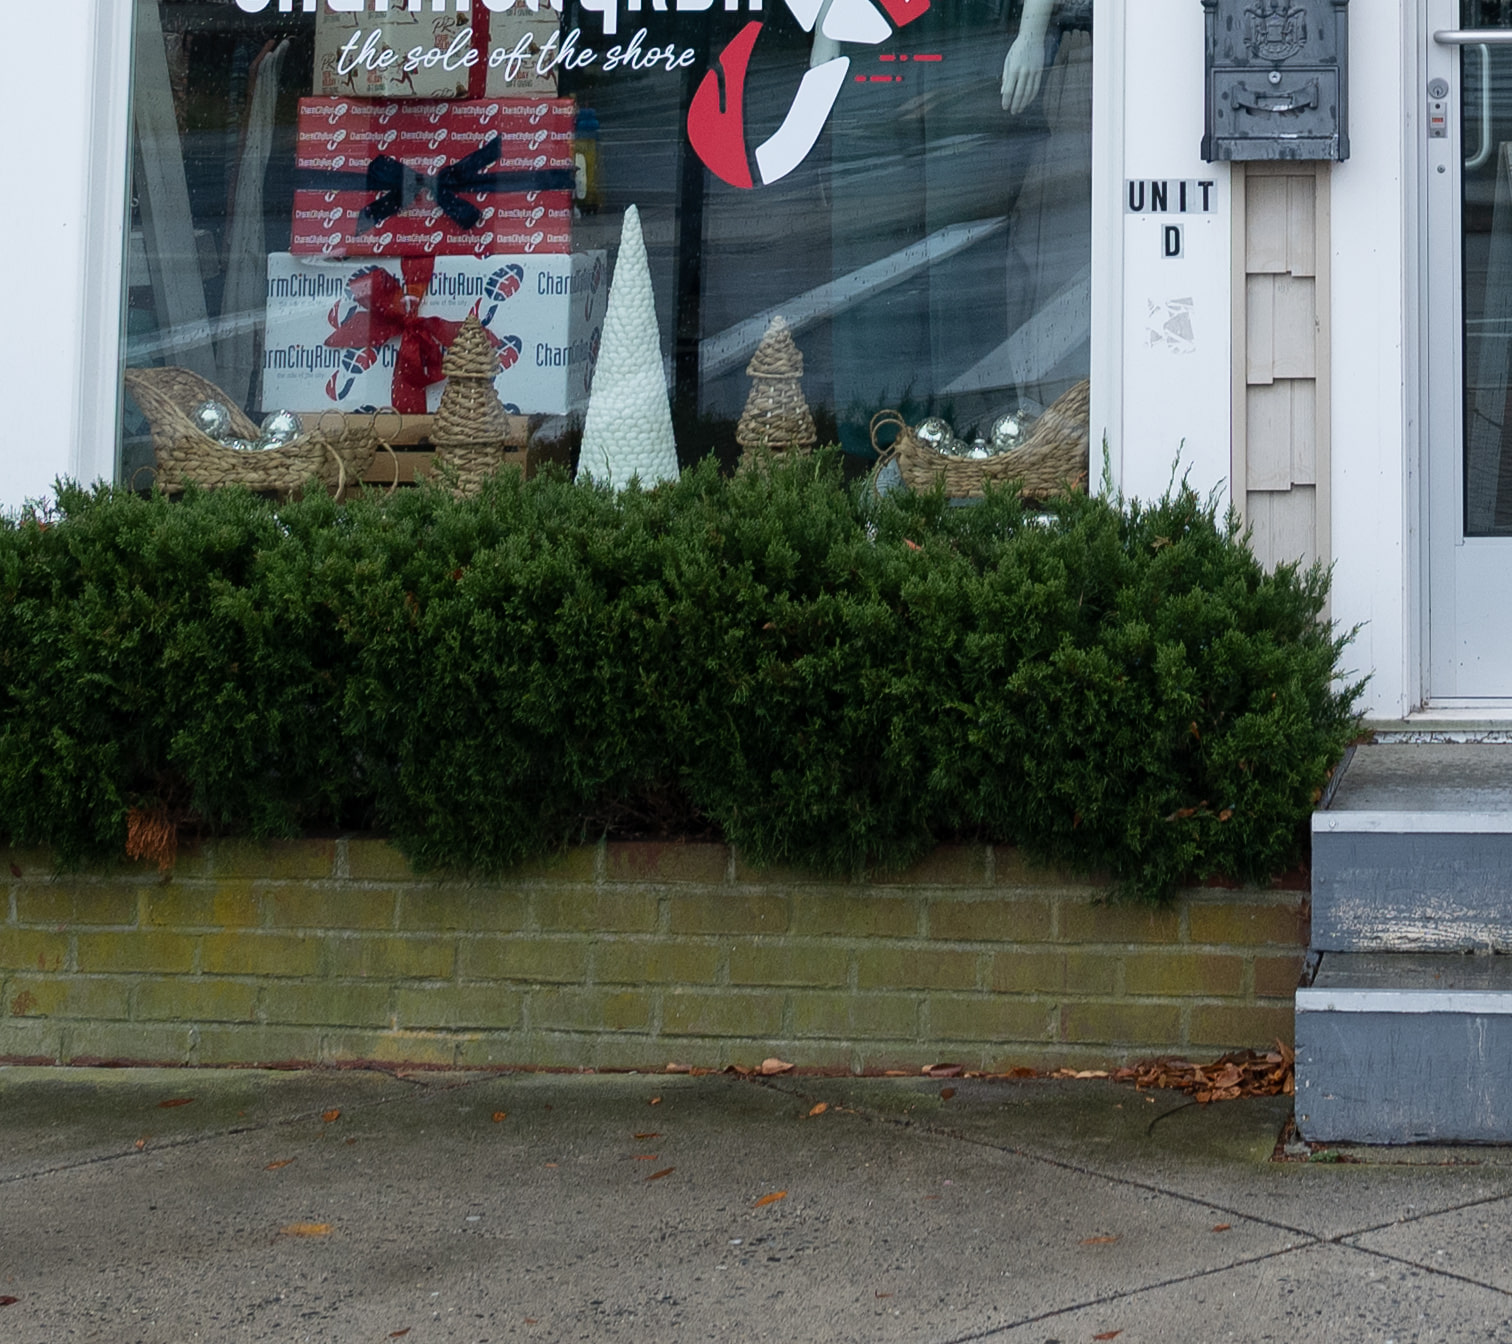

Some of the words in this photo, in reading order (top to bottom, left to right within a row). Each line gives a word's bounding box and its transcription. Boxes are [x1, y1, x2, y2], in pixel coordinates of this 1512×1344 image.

[337, 28, 399, 75] the
[403, 27, 479, 72] sole
[488, 31, 535, 82] of
[536, 28, 598, 75] the
[602, 27, 696, 72] shore
[1128, 180, 1216, 214] UNIT
[1164, 225, 1181, 257] D
